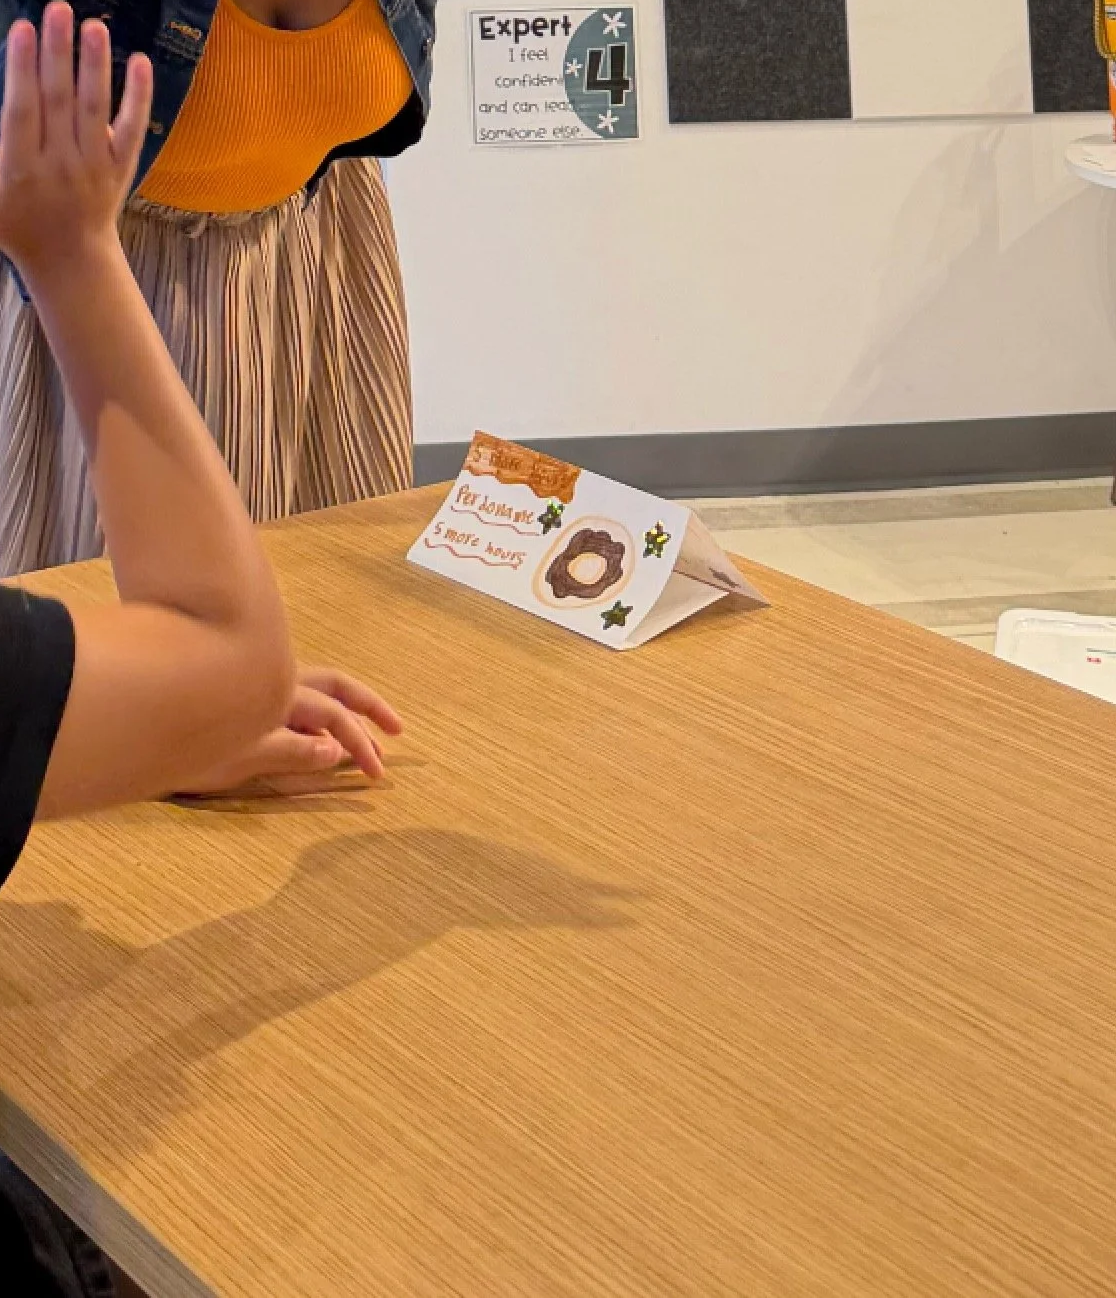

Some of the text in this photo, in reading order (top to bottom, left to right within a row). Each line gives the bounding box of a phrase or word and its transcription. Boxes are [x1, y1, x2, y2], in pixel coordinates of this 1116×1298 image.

[478, 14, 572, 44] Expert
[508, 47, 550, 63] I feel
[585, 43, 632, 106] 4
[478, 99, 508, 113] and
[512, 101, 540, 114] can
[478, 126, 548, 140] someone
[434, 521, 527, 565] 5 more hours
